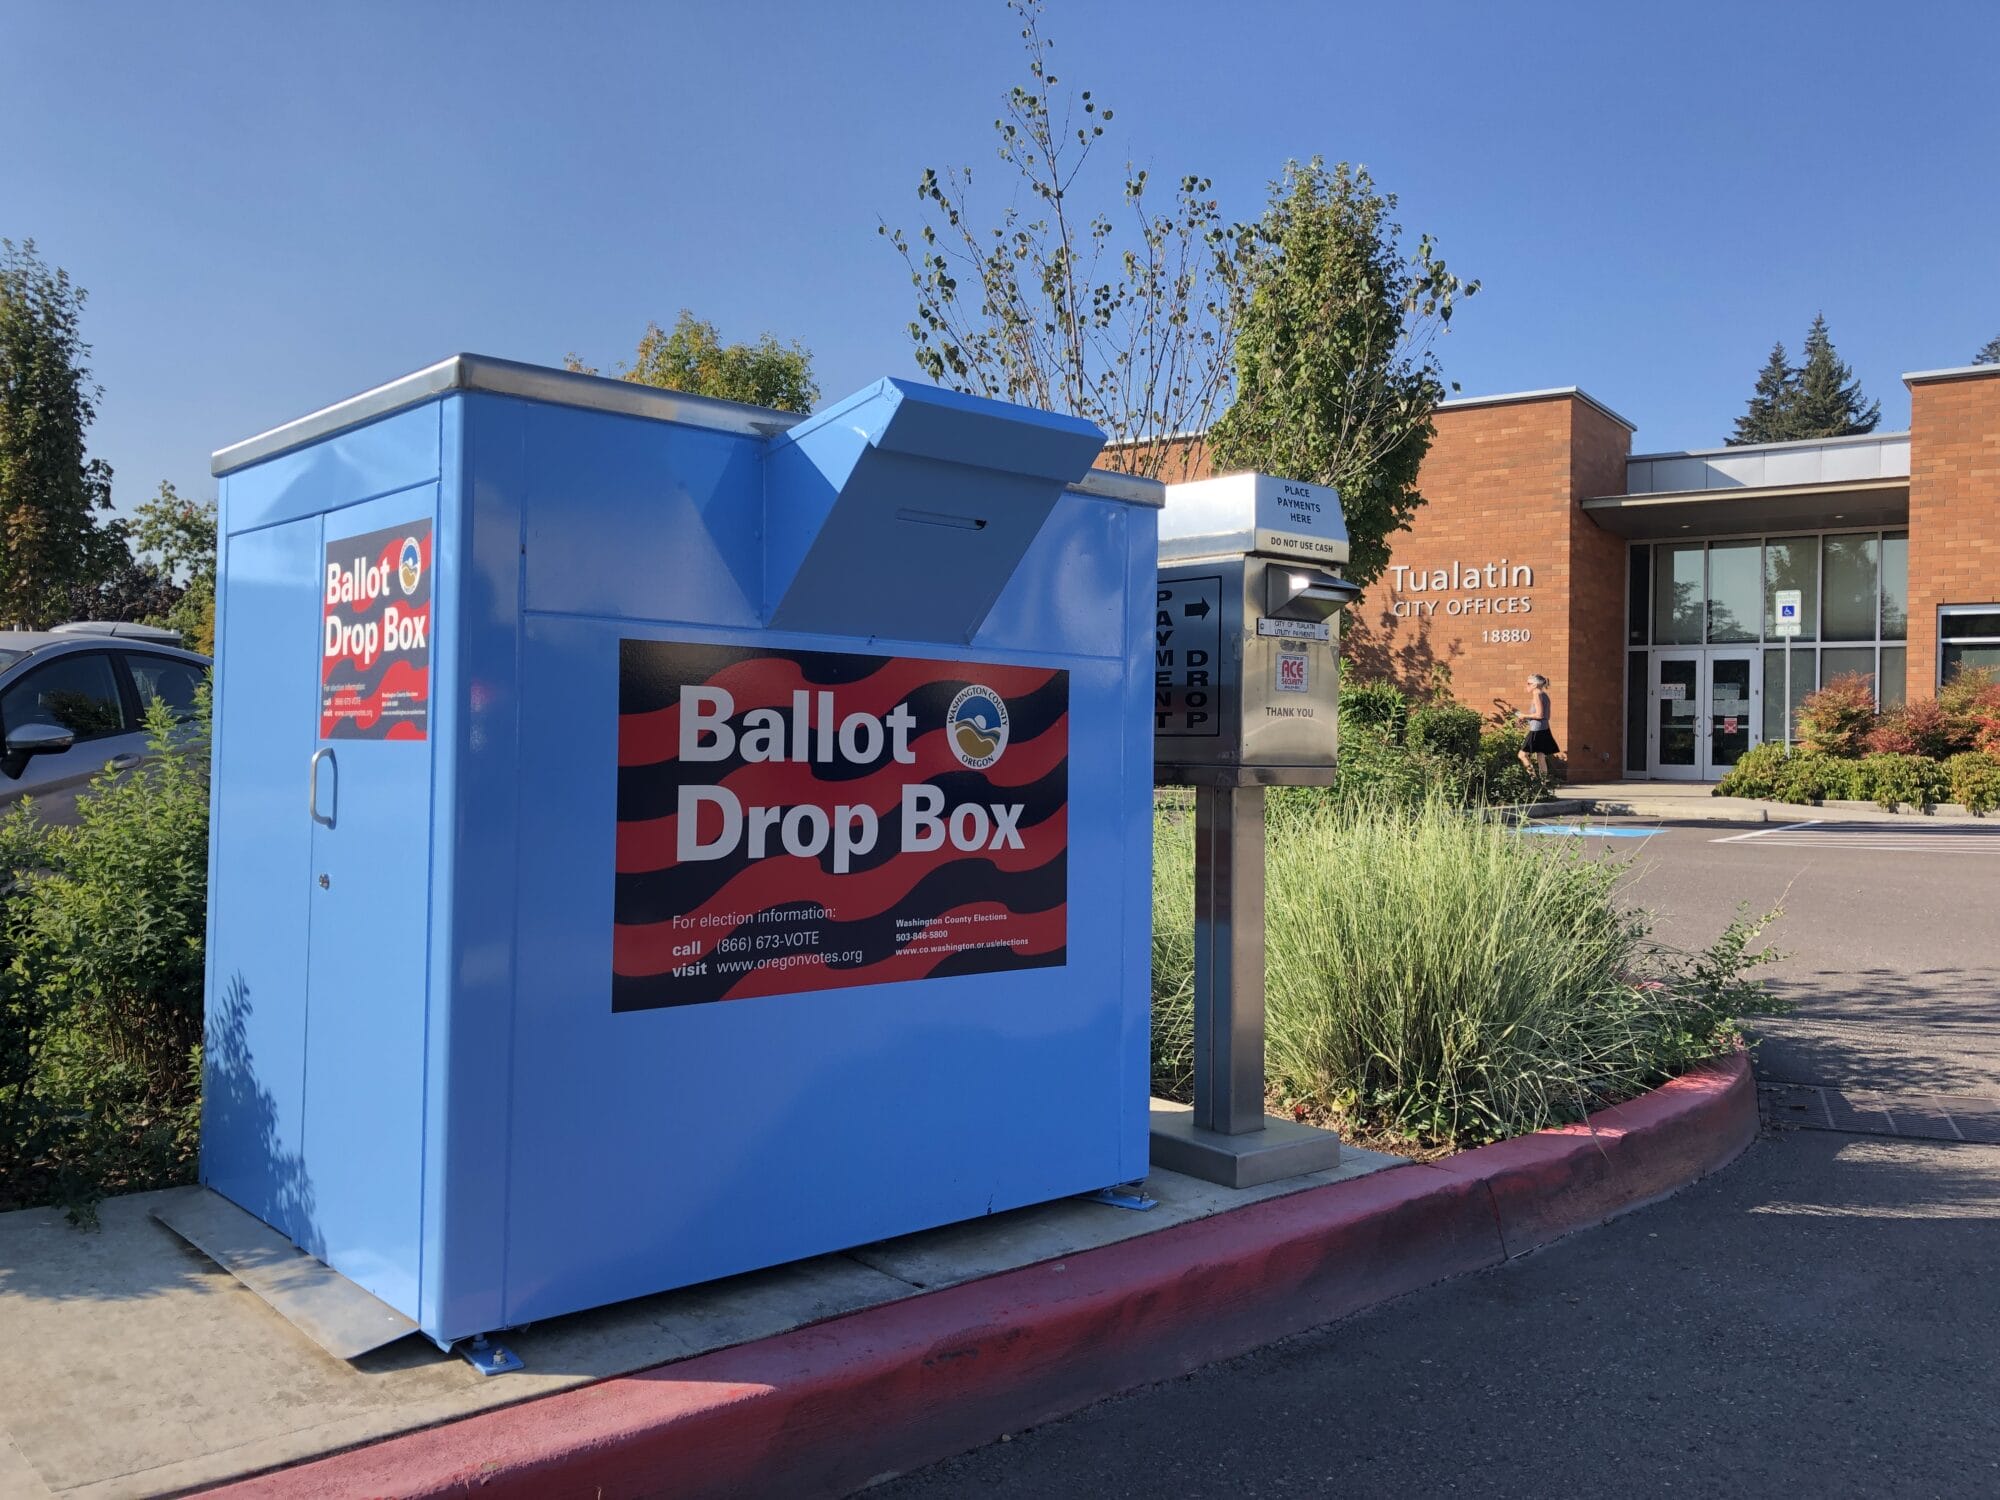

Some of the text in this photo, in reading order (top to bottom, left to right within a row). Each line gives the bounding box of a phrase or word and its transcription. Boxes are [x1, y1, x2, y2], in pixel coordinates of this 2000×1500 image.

[1284, 485, 1311, 498] PLACE
[1277, 496, 1321, 513] PAYMENTS
[1290, 512, 1312, 525] HERE
[1270, 536, 1334, 553] DO NOT USE CASH
[326, 556, 390, 605] Ballot
[1390, 558, 1534, 592] Tualatin
[1393, 596, 1533, 617] CITY OFFICES
[325, 606, 426, 665] Drop Box
[1482, 628, 1532, 643] 18880
[1281, 659, 1304, 679] ACE
[1185, 649, 1209, 729] DROP
[1280, 678, 1304, 686] SECURITY
[947, 686, 1008, 727] WASHINGTON COUNTY
[1265, 706, 1314, 718] THANK YOU
[678, 684, 916, 765] Ballot
[961, 754, 994, 768] OREGON
[676, 783, 1025, 875] Drop Box
[672, 906, 837, 930] For election information:
[895, 912, 1008, 928] Washington County Elections
[672, 930, 820, 957] call (866) 673-VOTE
[895, 930, 948, 942] 503-846-5800
[672, 949, 863, 978] visit www.oregonvotes.org
